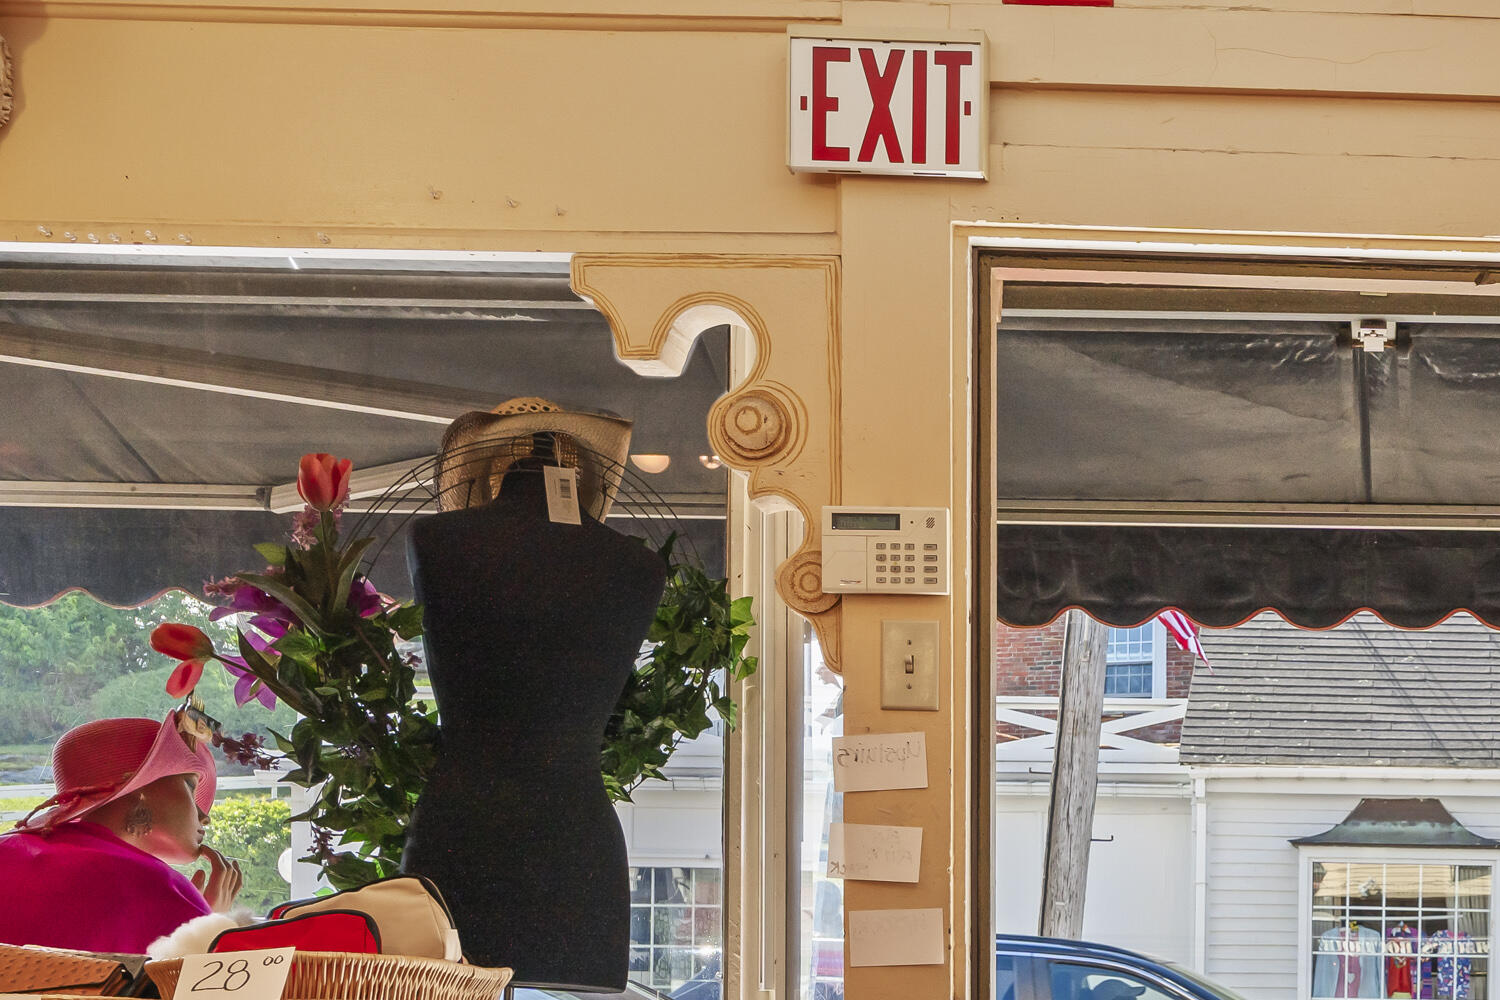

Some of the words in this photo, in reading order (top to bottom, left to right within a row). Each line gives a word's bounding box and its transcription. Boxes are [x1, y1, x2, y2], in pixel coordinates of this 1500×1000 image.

[812, 46, 973, 165] EXIT
[191, 959, 251, 992] 28
[262, 955, 284, 966] 00
